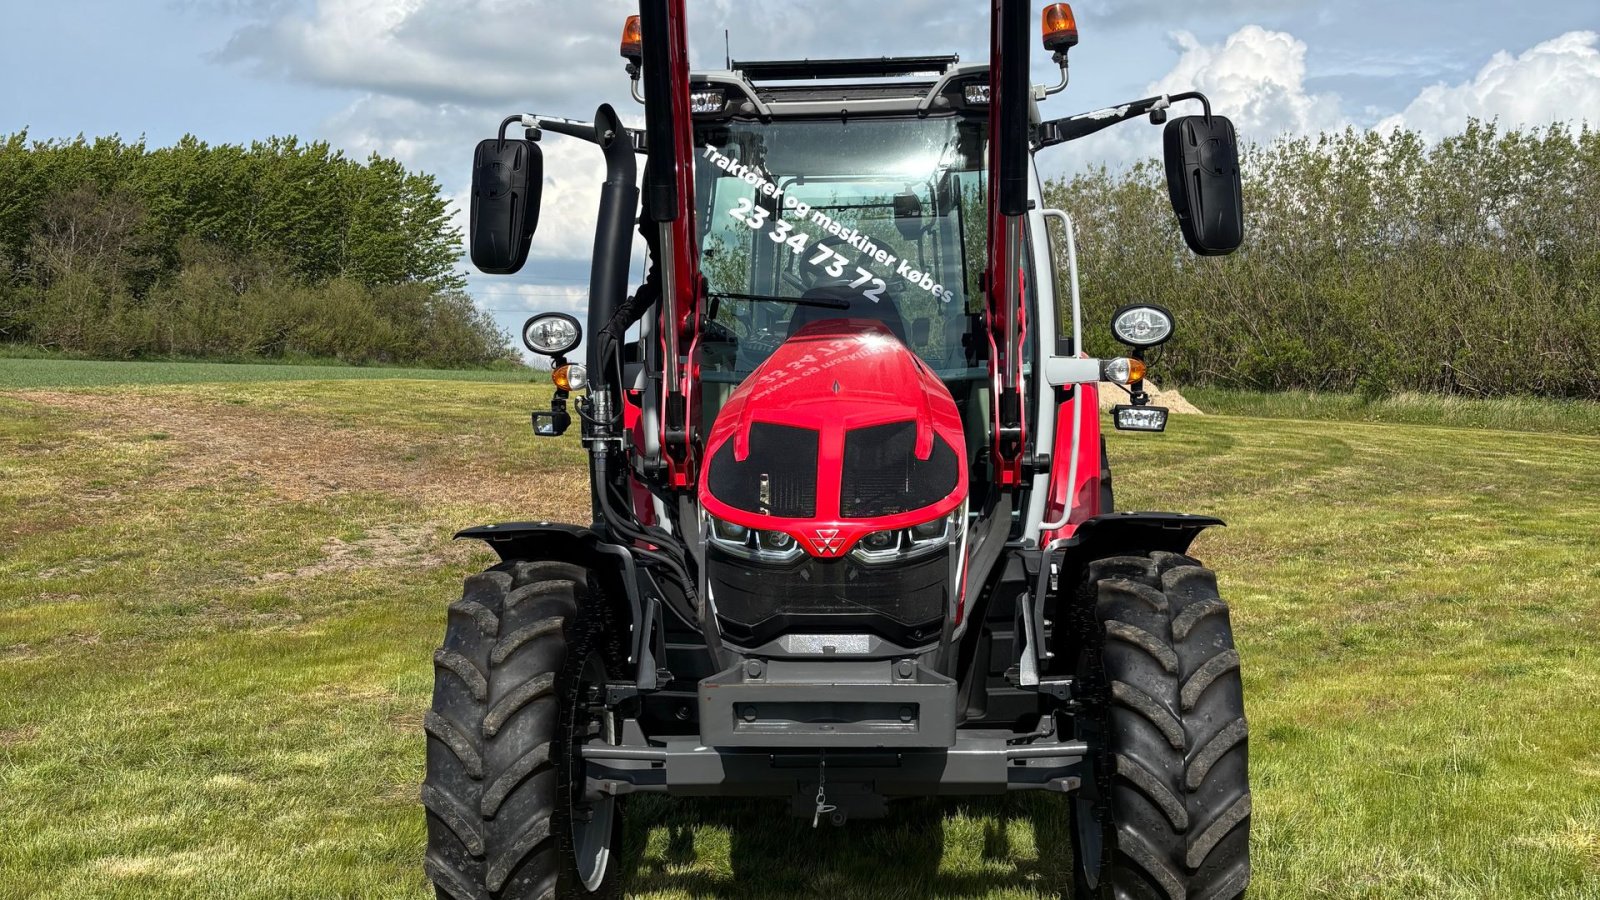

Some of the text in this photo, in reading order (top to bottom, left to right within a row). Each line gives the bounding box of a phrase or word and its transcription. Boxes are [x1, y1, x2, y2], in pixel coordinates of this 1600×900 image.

[702, 143, 954, 303] Traktorer og maskiner købes
[729, 197, 887, 303] 23 34 73 72
